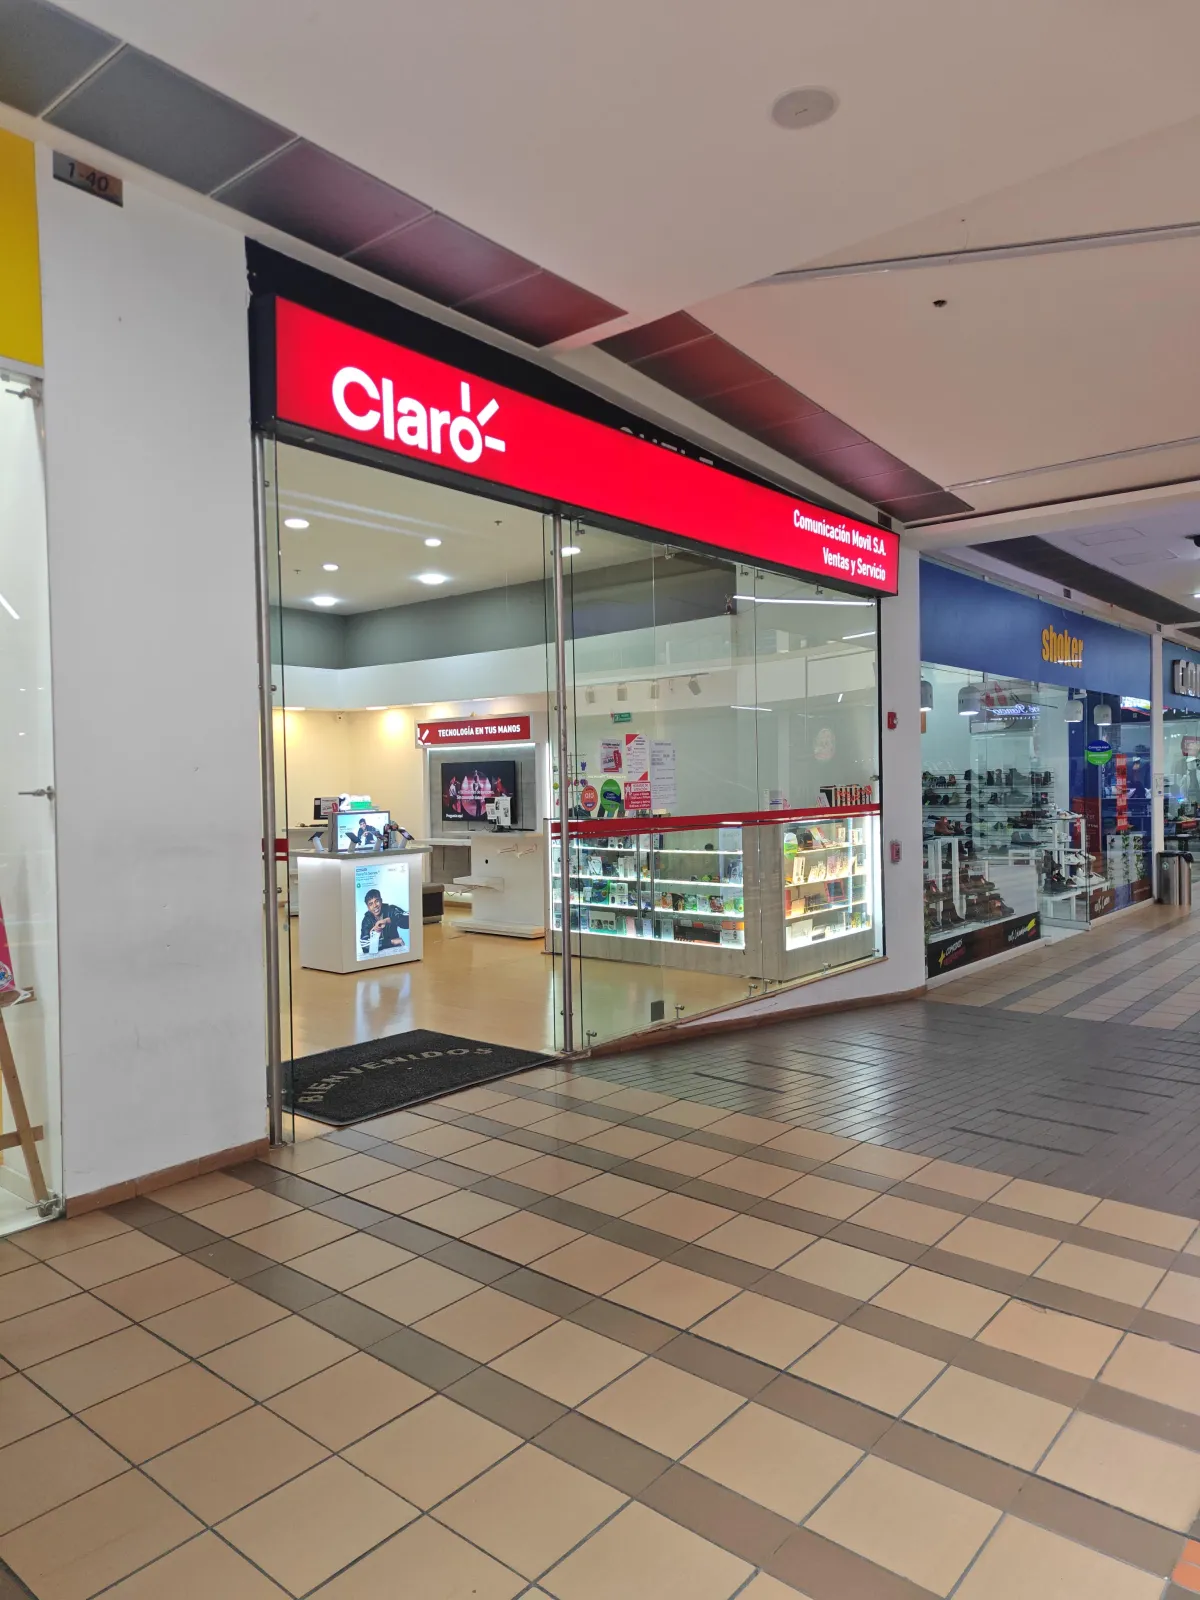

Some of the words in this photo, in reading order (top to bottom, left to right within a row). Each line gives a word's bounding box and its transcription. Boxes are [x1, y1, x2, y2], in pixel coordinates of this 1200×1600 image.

[332, 366, 483, 463] Claro
[793, 509, 850, 544] Comunicación
[852, 530, 872, 551] Movil
[873, 537, 887, 556] S.A.
[822, 546, 850, 571] Ventas
[850, 559, 856, 576] y
[857, 558, 886, 581] Servicio
[1041, 624, 1084, 668] shoker
[438, 726, 474, 737] TECNOLOGÍA
[475, 727, 484, 735] EN
[485, 726, 497, 734] TUS
[498, 724, 521, 734] MANOS
[298, 1047, 494, 1103] BIENVENIDOS
